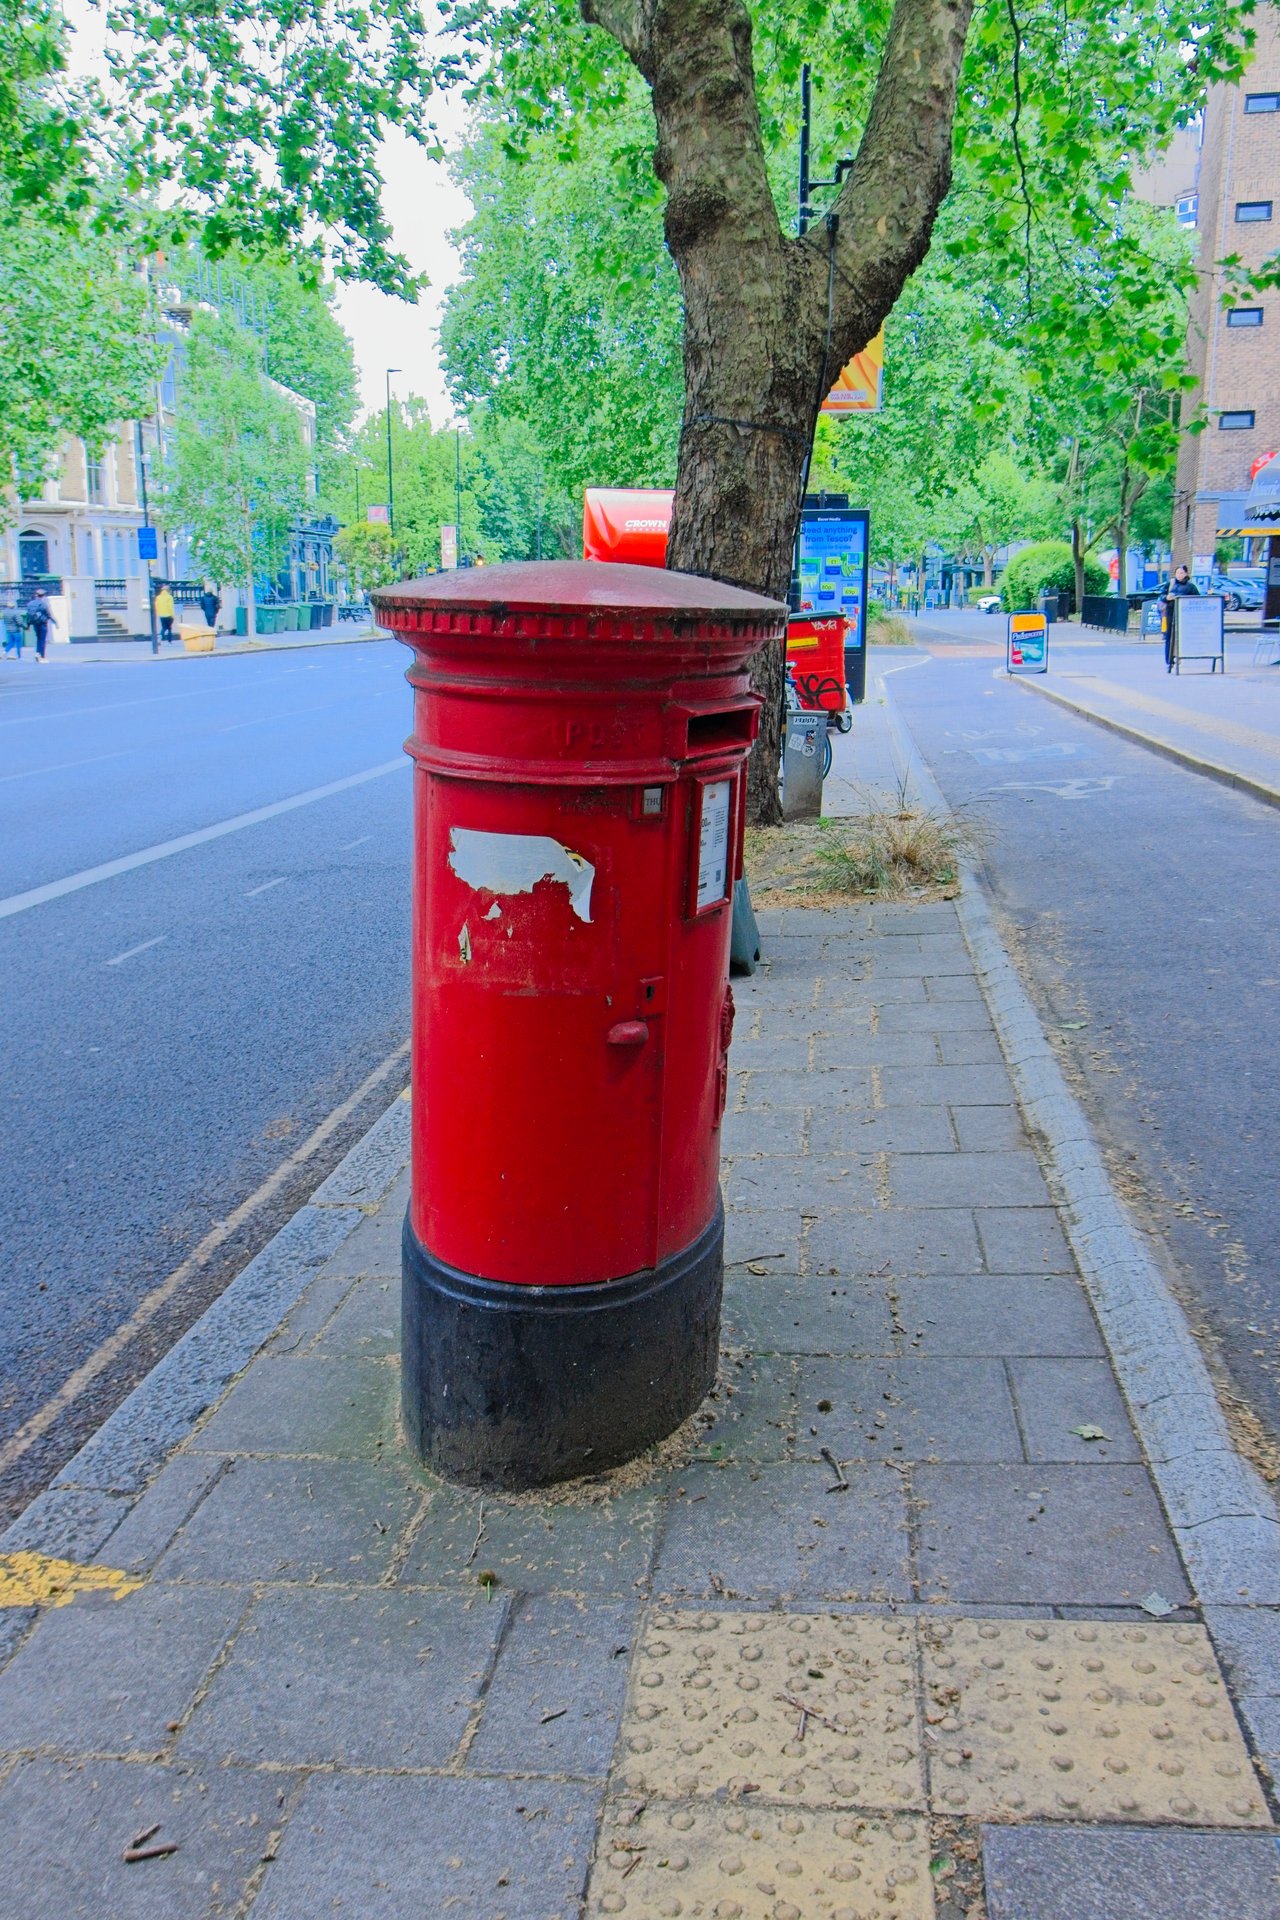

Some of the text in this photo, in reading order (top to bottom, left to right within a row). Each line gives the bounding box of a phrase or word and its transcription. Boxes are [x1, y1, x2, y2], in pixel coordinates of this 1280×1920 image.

[625, 519, 667, 528] CROWN
[824, 526, 858, 535] anything
[565, 720, 645, 749] POST
[645, 797, 661, 807] THU
